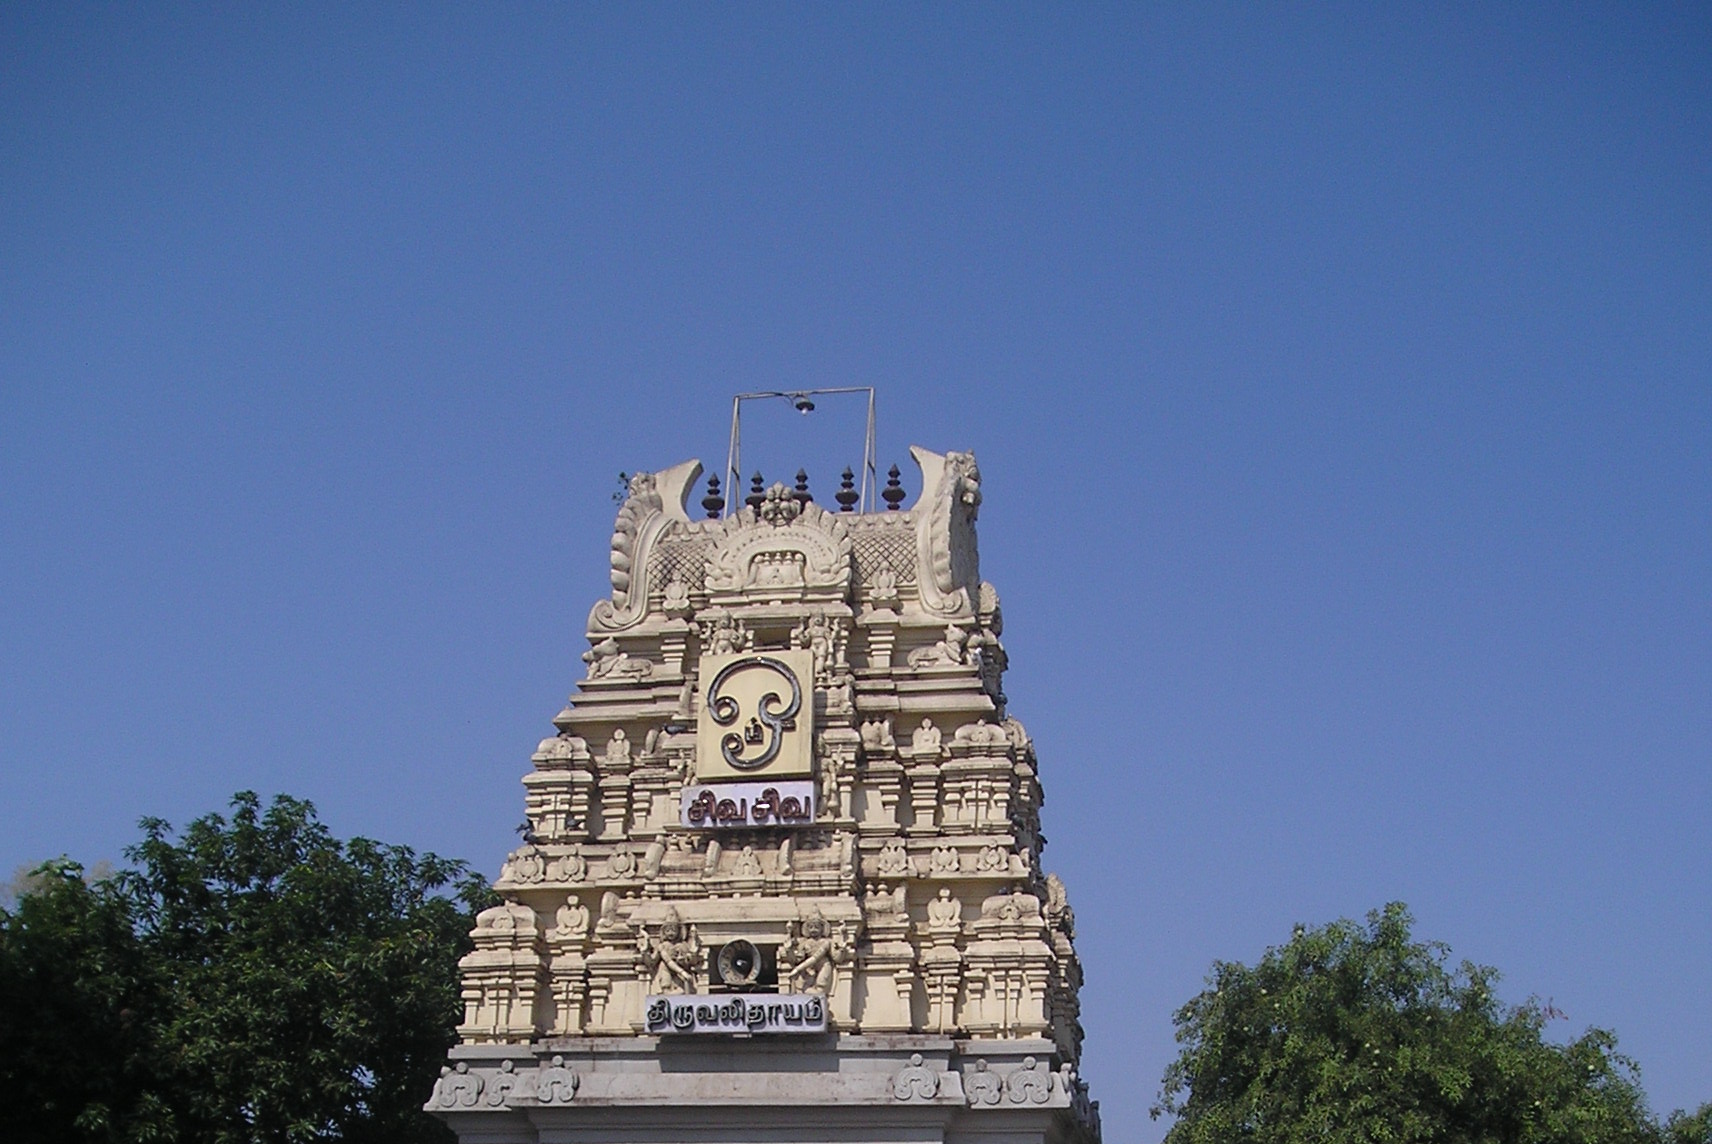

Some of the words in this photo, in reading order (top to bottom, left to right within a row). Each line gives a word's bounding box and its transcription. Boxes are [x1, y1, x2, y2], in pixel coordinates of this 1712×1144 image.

[687, 789, 747, 824] சிவ
[751, 787, 811, 822] சிவ
[647, 997, 823, 1030] திருவலிதாயம்
